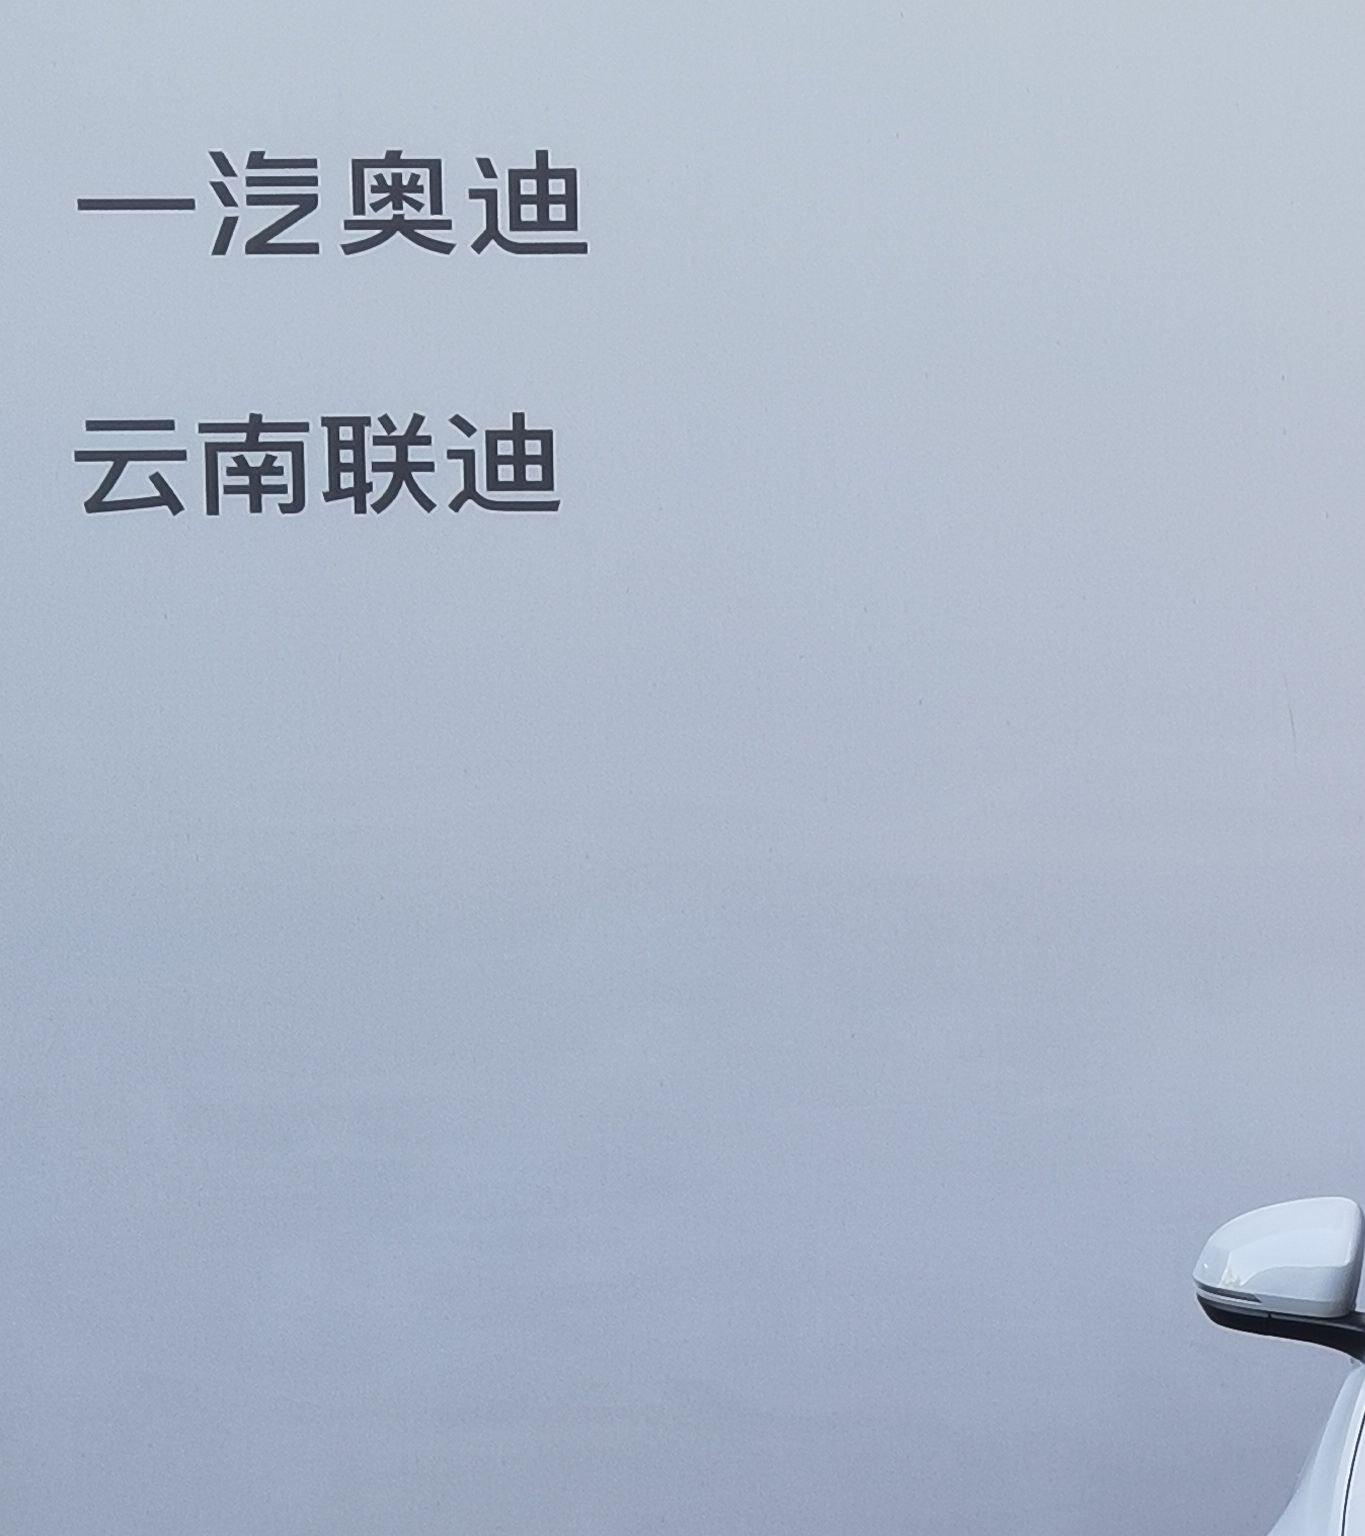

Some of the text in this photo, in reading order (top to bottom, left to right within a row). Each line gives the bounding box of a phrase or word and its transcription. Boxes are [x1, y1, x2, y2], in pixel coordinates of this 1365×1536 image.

[77, 149, 589, 256] 一汽奥迪
[74, 411, 561, 516] 云南联迪
